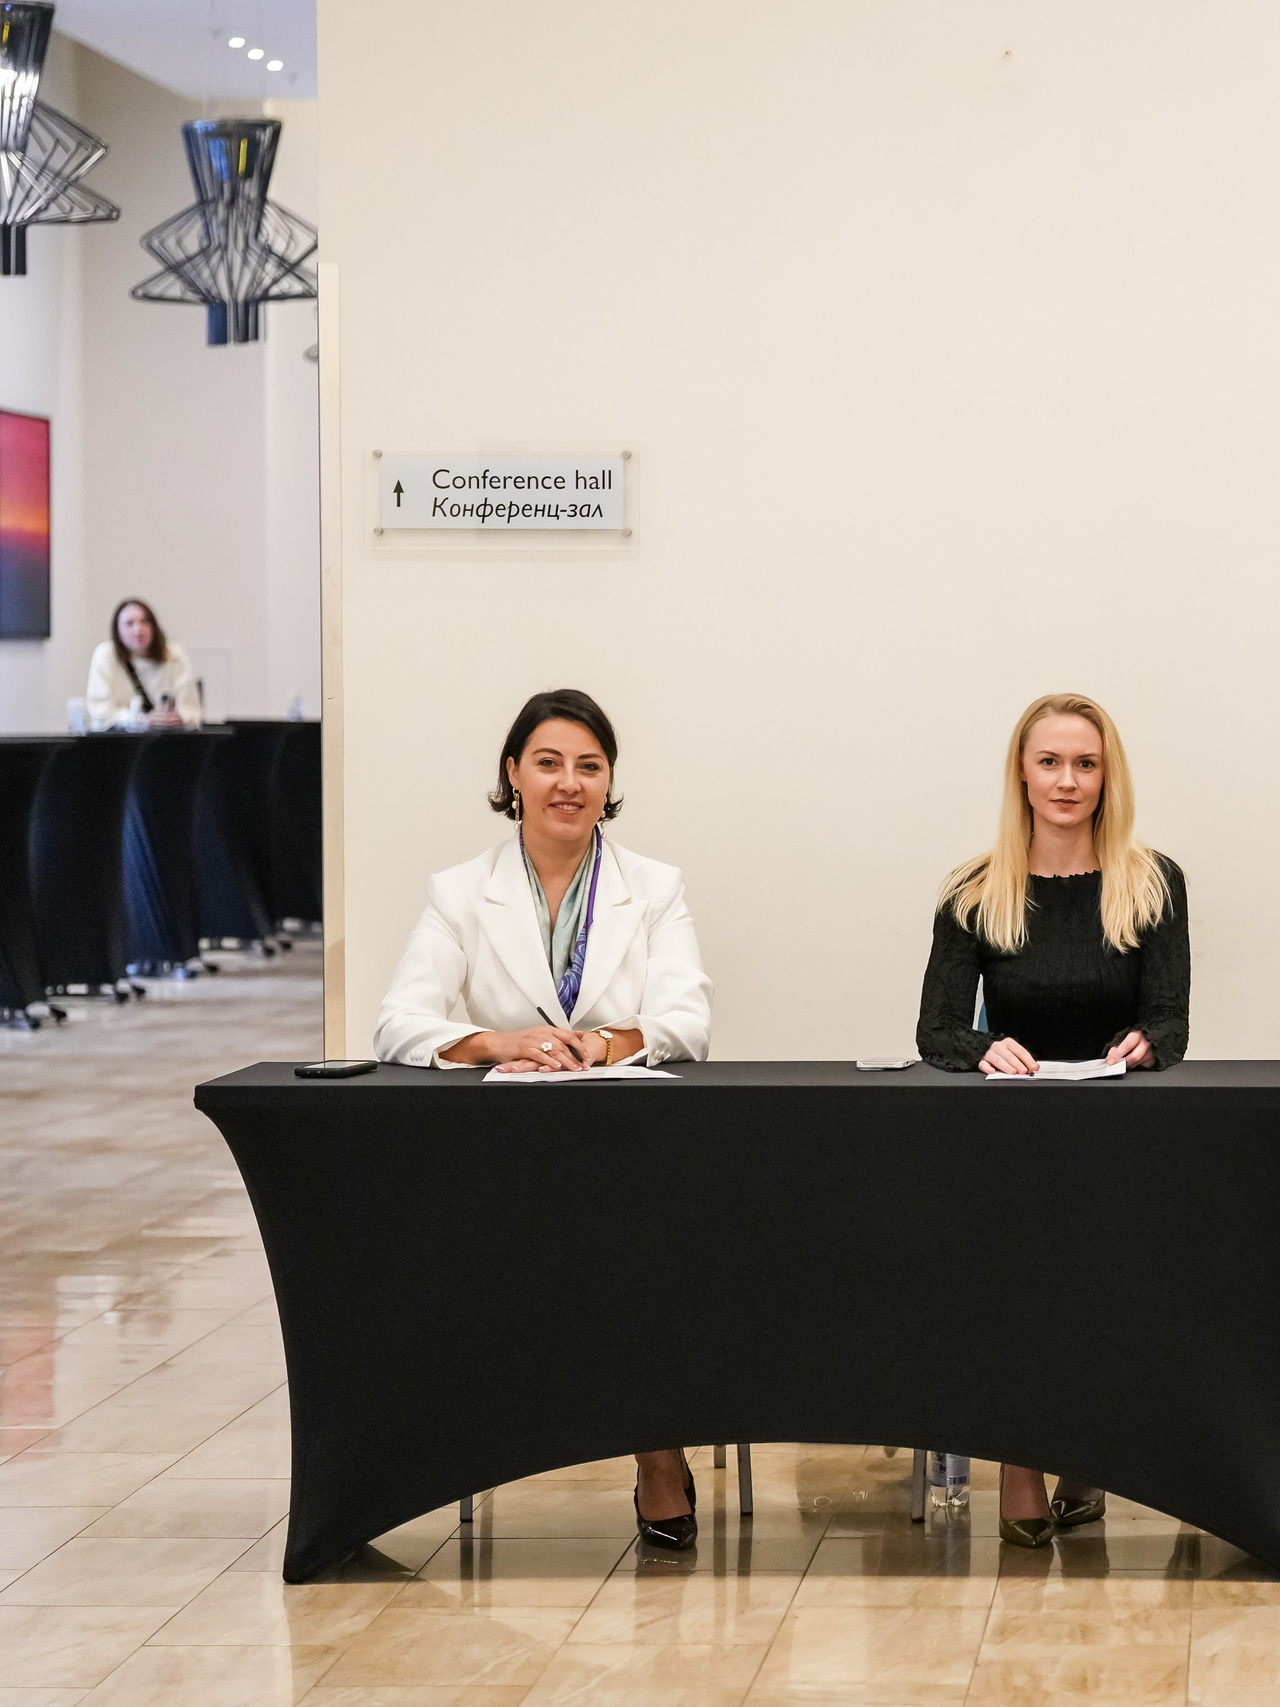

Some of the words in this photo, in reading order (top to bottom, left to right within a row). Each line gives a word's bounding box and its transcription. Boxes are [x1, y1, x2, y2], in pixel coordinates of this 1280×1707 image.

[431, 467, 567, 491] Conference
[574, 468, 613, 491] hall
[431, 496, 605, 525] Конференц-зал
